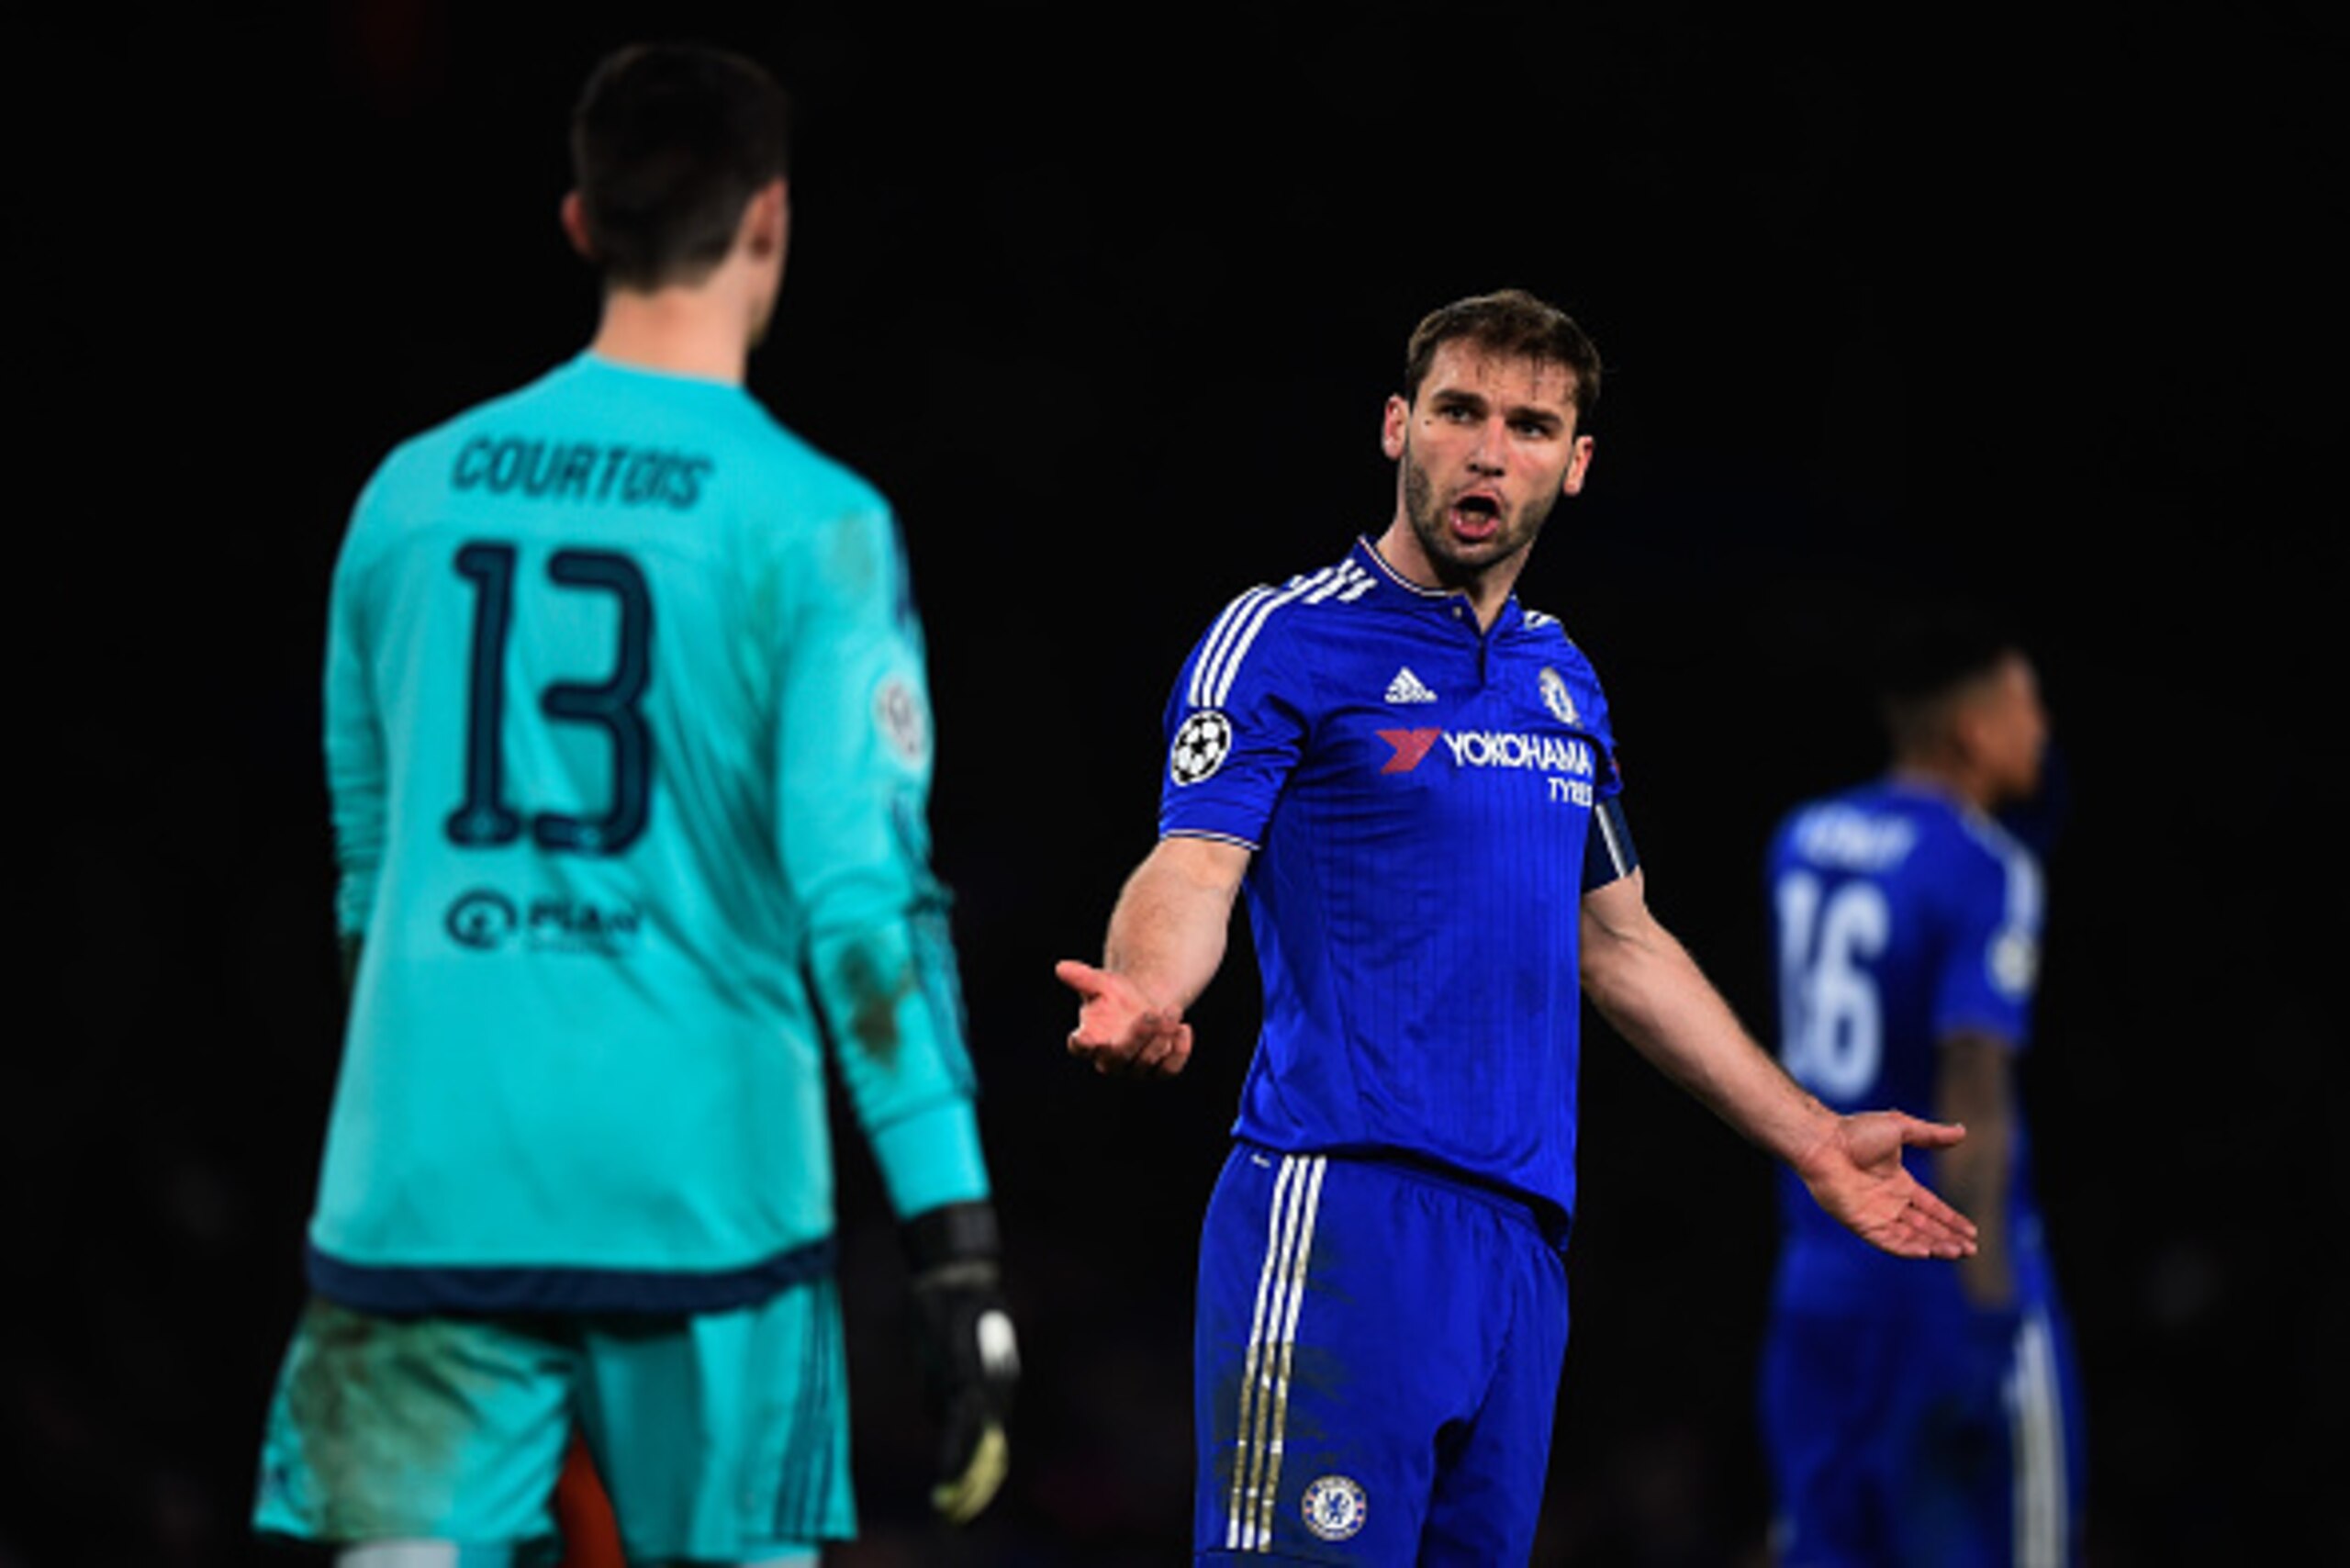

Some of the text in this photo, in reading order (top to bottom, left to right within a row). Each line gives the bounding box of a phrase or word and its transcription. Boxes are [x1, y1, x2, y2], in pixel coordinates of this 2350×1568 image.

[453, 435, 714, 510] COURTOIS
[446, 540, 656, 858] 13
[1441, 731, 1594, 778] YOKOHAMA
[1777, 869, 1890, 1102] 16
